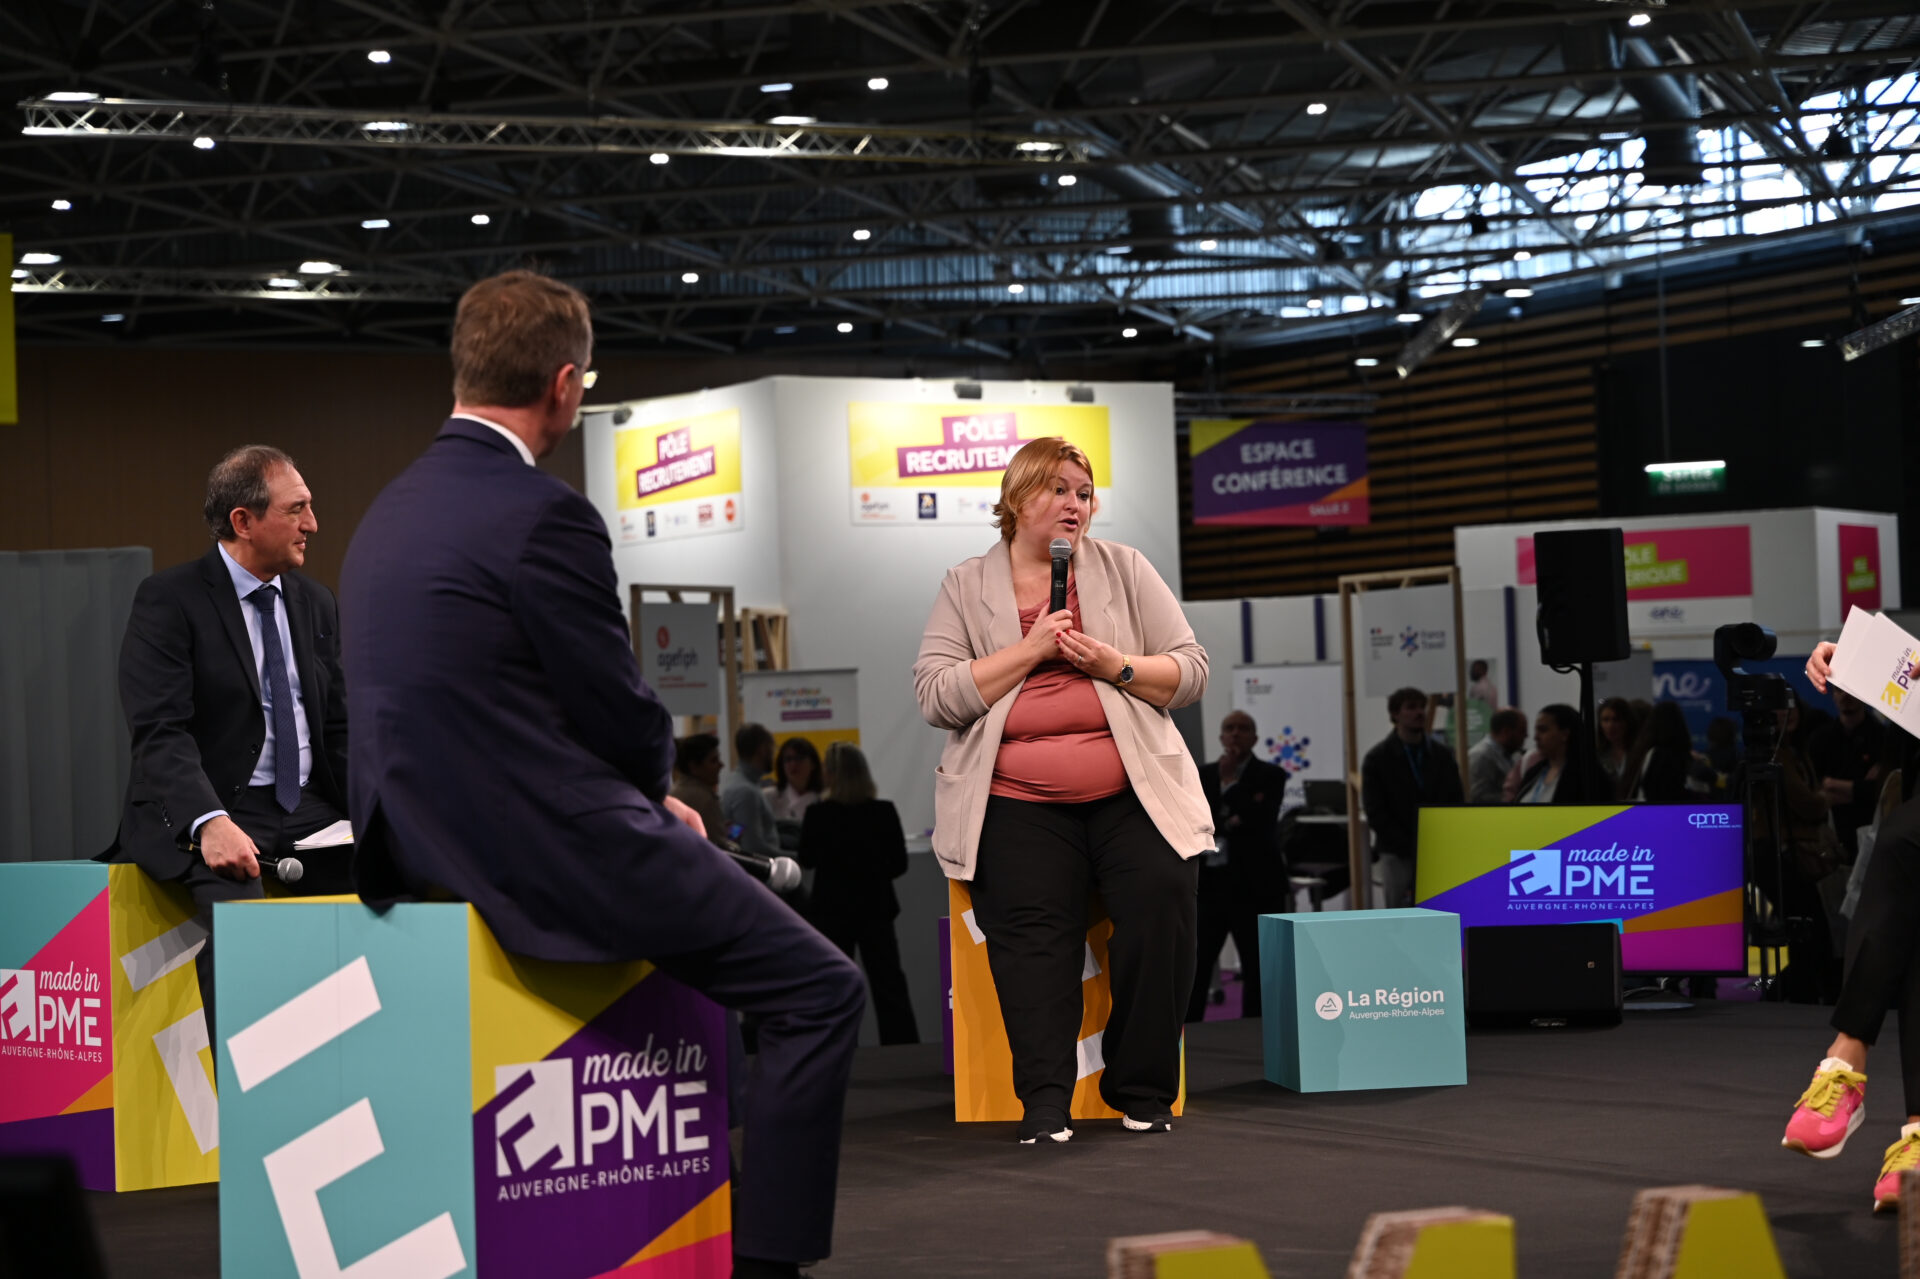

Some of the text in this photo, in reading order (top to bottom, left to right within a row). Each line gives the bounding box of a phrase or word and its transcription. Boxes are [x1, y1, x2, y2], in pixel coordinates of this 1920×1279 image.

[953, 417, 1008, 442] PÔLE
[659, 432, 689, 460] PÔLE
[905, 444, 1024, 473] RECRUTEM
[1240, 438, 1316, 464] ESPACE
[637, 451, 714, 494] RECRUTEMENT
[1212, 464, 1347, 495] CONFÉRENCE
[1688, 813, 1729, 829] cpme
[1568, 842, 1655, 862] made in
[1565, 865, 1654, 896] PME
[1507, 902, 1655, 911] AUVERGNE-RHÔNE-ALPES
[39, 961, 100, 993] made in
[1348, 987, 1444, 1008] La Région
[39, 995, 102, 1047] PME
[1349, 1007, 1445, 1021] Auvergne-Rhône-Alpes
[1, 1045, 103, 1064] AUVERGNE-RHÔNE-ALPES
[582, 1033, 707, 1086] made in
[581, 1080, 709, 1166] PME
[498, 1157, 711, 1202] AUVERGNE-RHÔNE-ALPES
